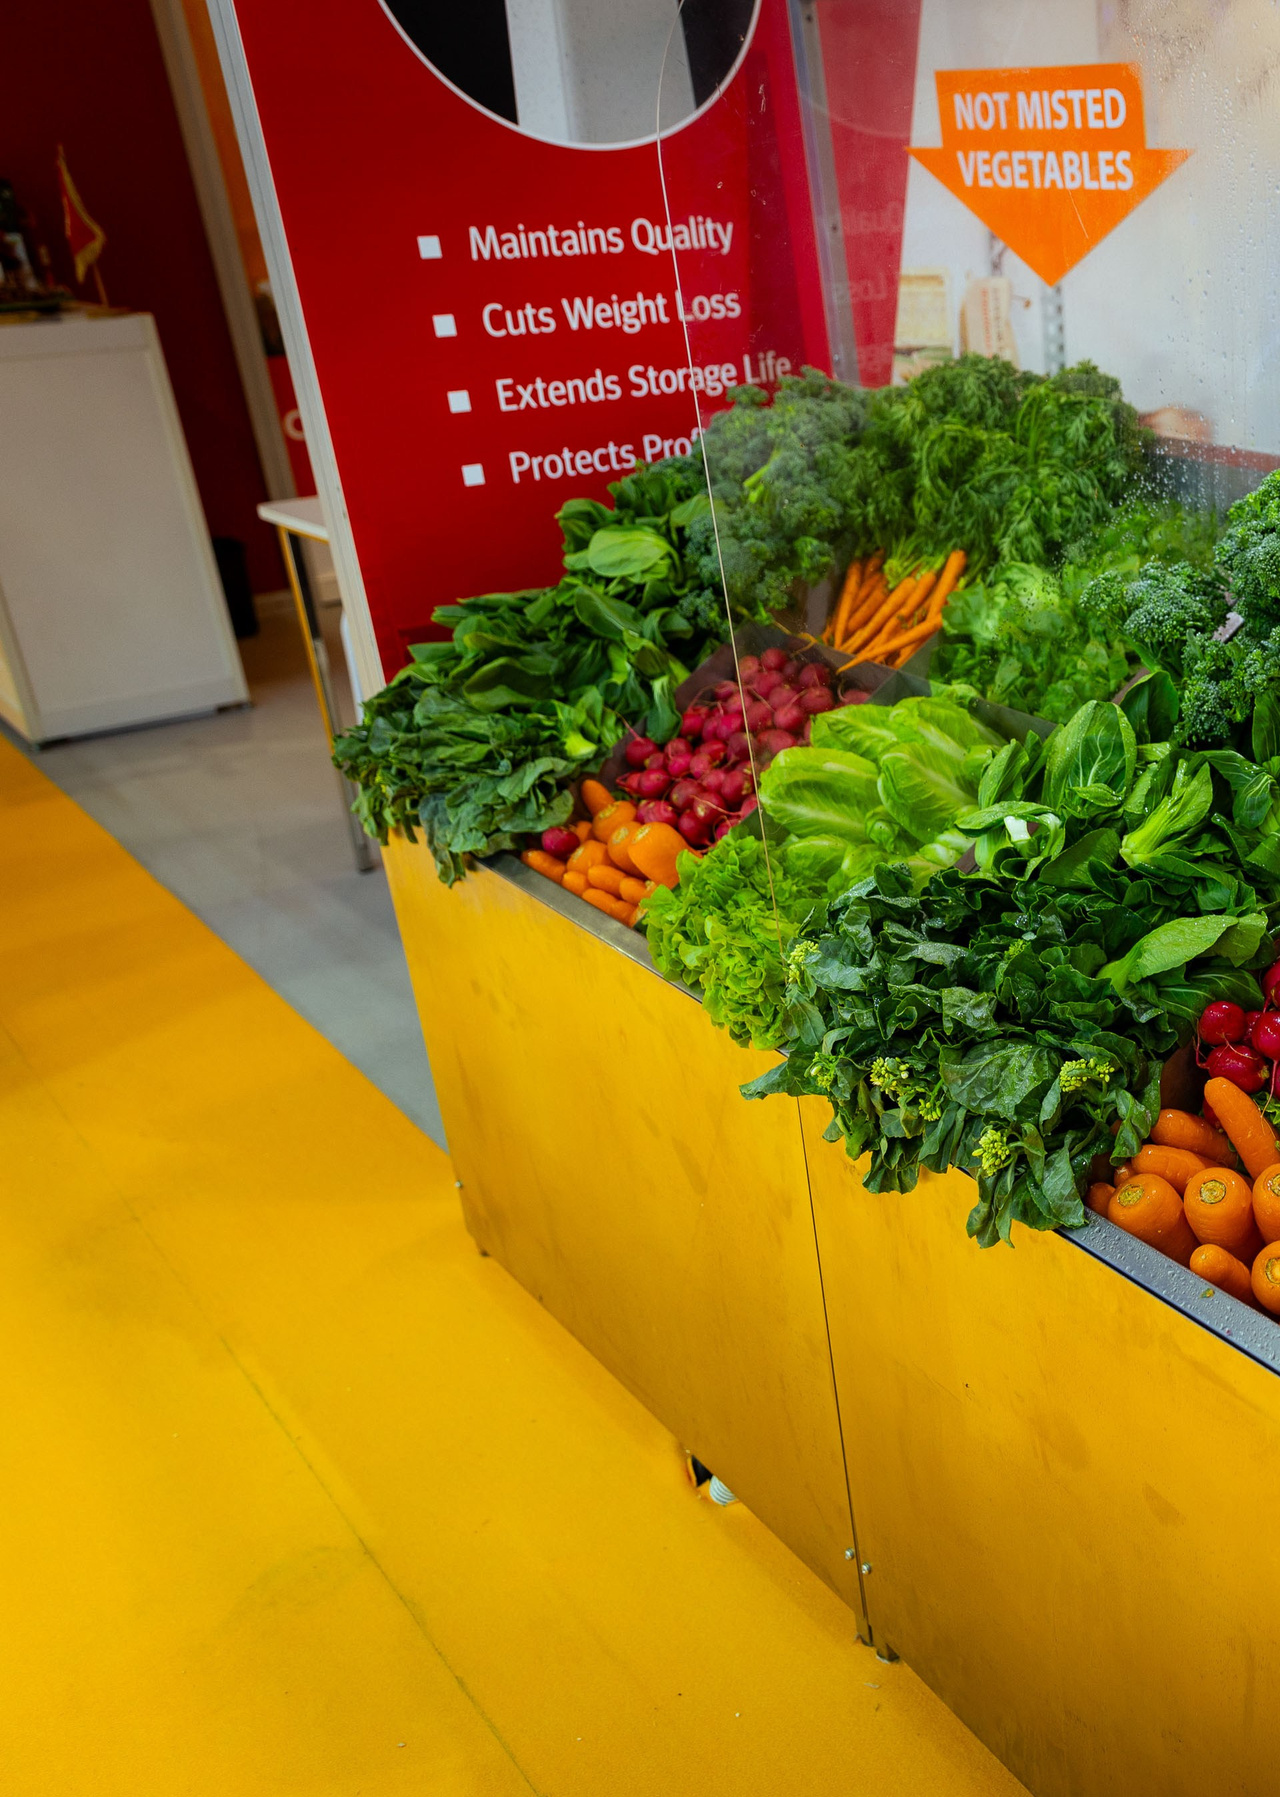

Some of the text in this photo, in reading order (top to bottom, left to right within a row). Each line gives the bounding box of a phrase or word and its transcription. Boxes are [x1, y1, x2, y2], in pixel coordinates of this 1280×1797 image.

[953, 88, 1127, 131] NOT MISTED
[956, 150, 1134, 191] VEGETABLES
[468, 215, 734, 261] Maintains Quality
[481, 289, 742, 338] Cuts Weight Loss
[495, 349, 792, 412] Extends Storage Life
[508, 441, 637, 484] Protects
